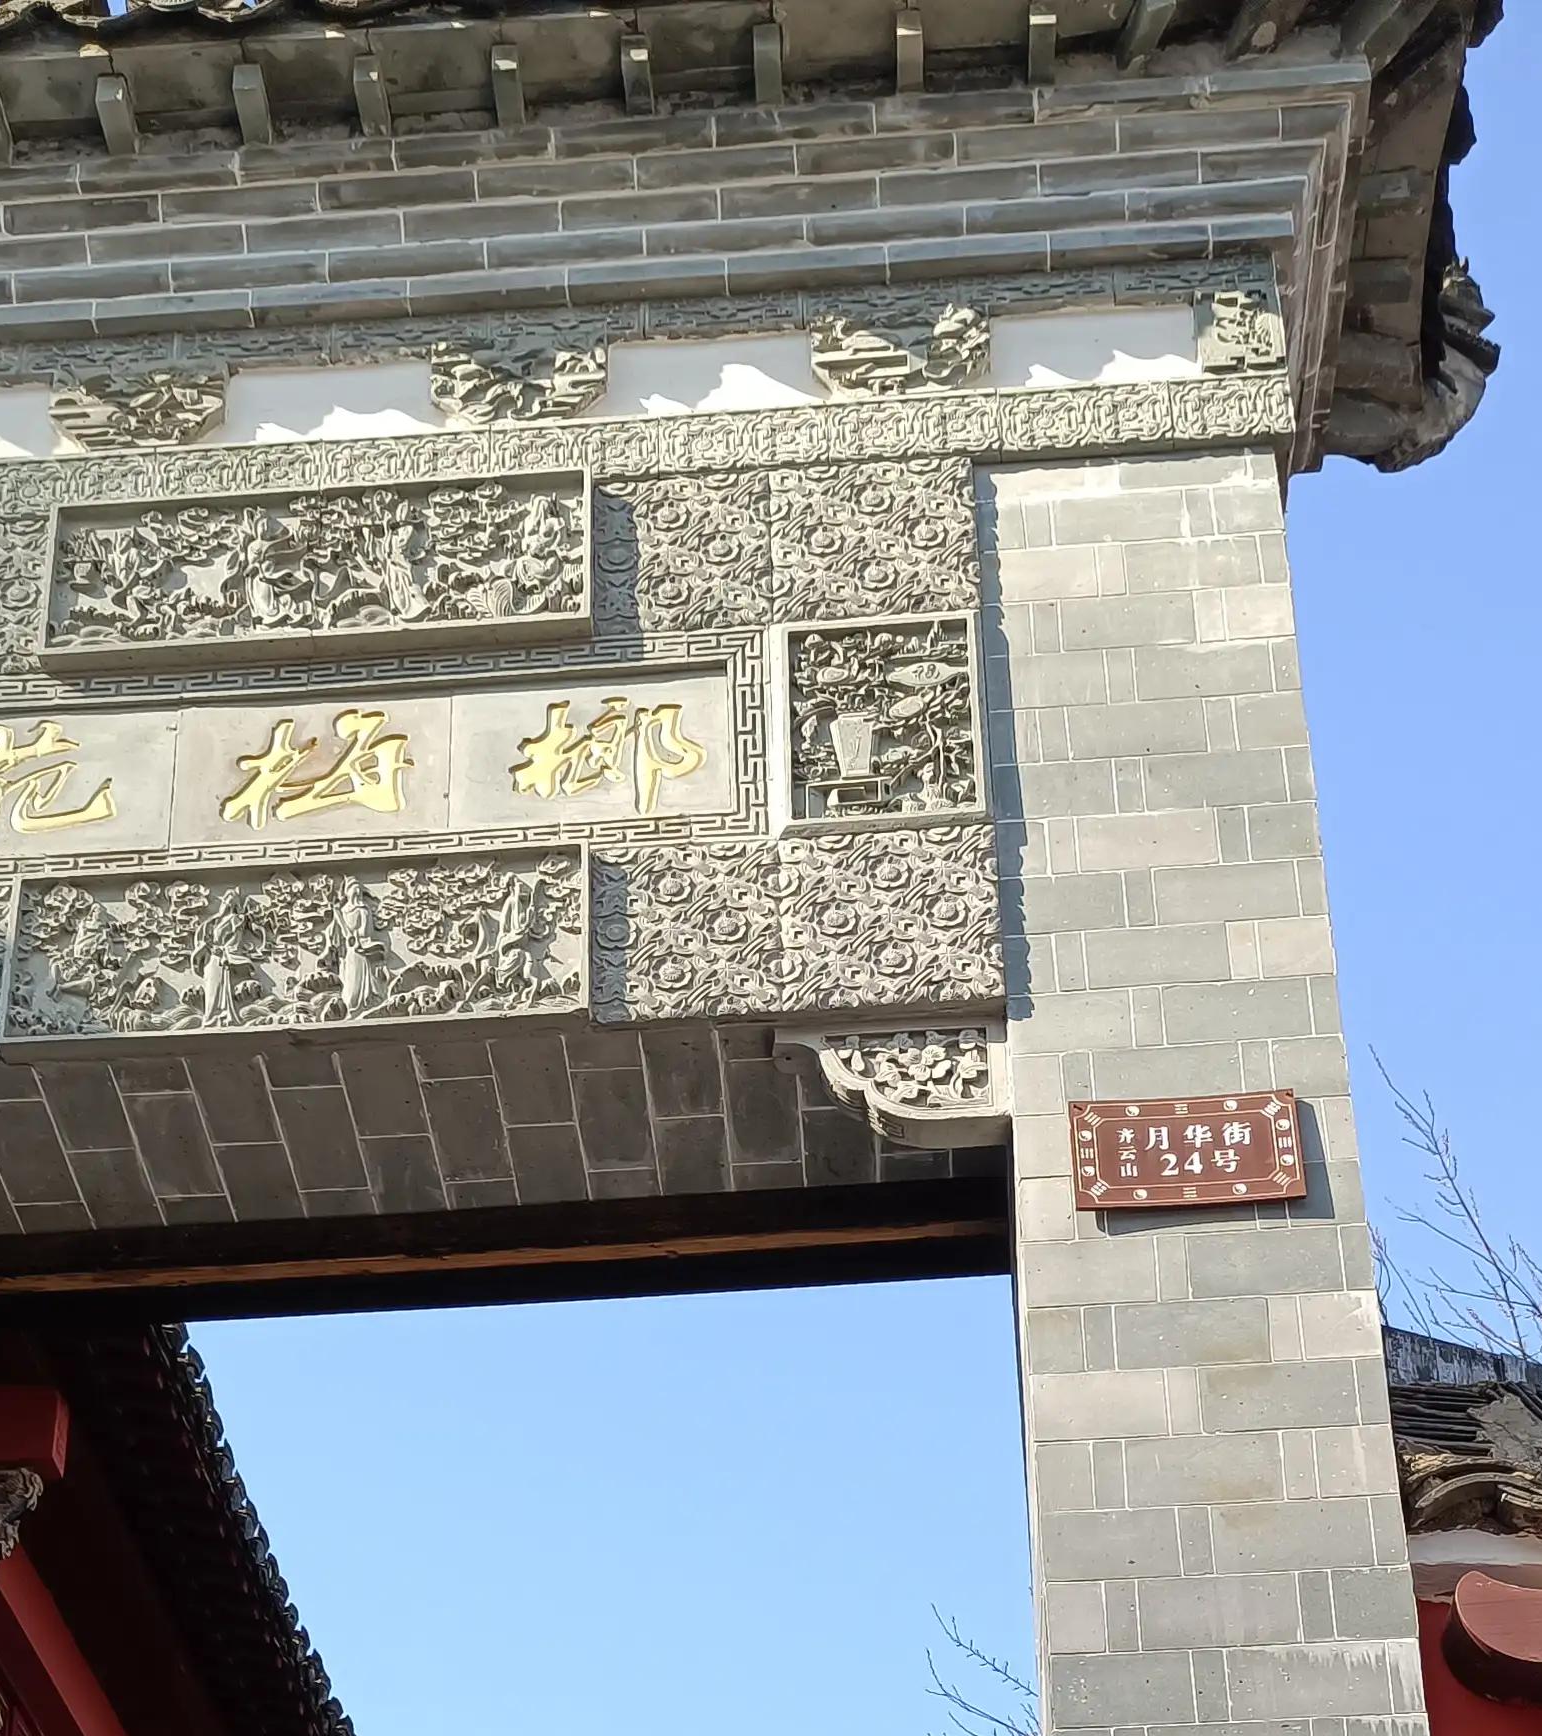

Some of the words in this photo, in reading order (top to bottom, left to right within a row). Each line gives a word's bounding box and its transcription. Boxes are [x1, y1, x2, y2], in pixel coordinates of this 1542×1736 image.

[1145, 1121, 1251, 1151] 月华街
[1116, 1127, 1138, 1178] 齐云山
[1160, 1149, 1240, 1176] 24号
